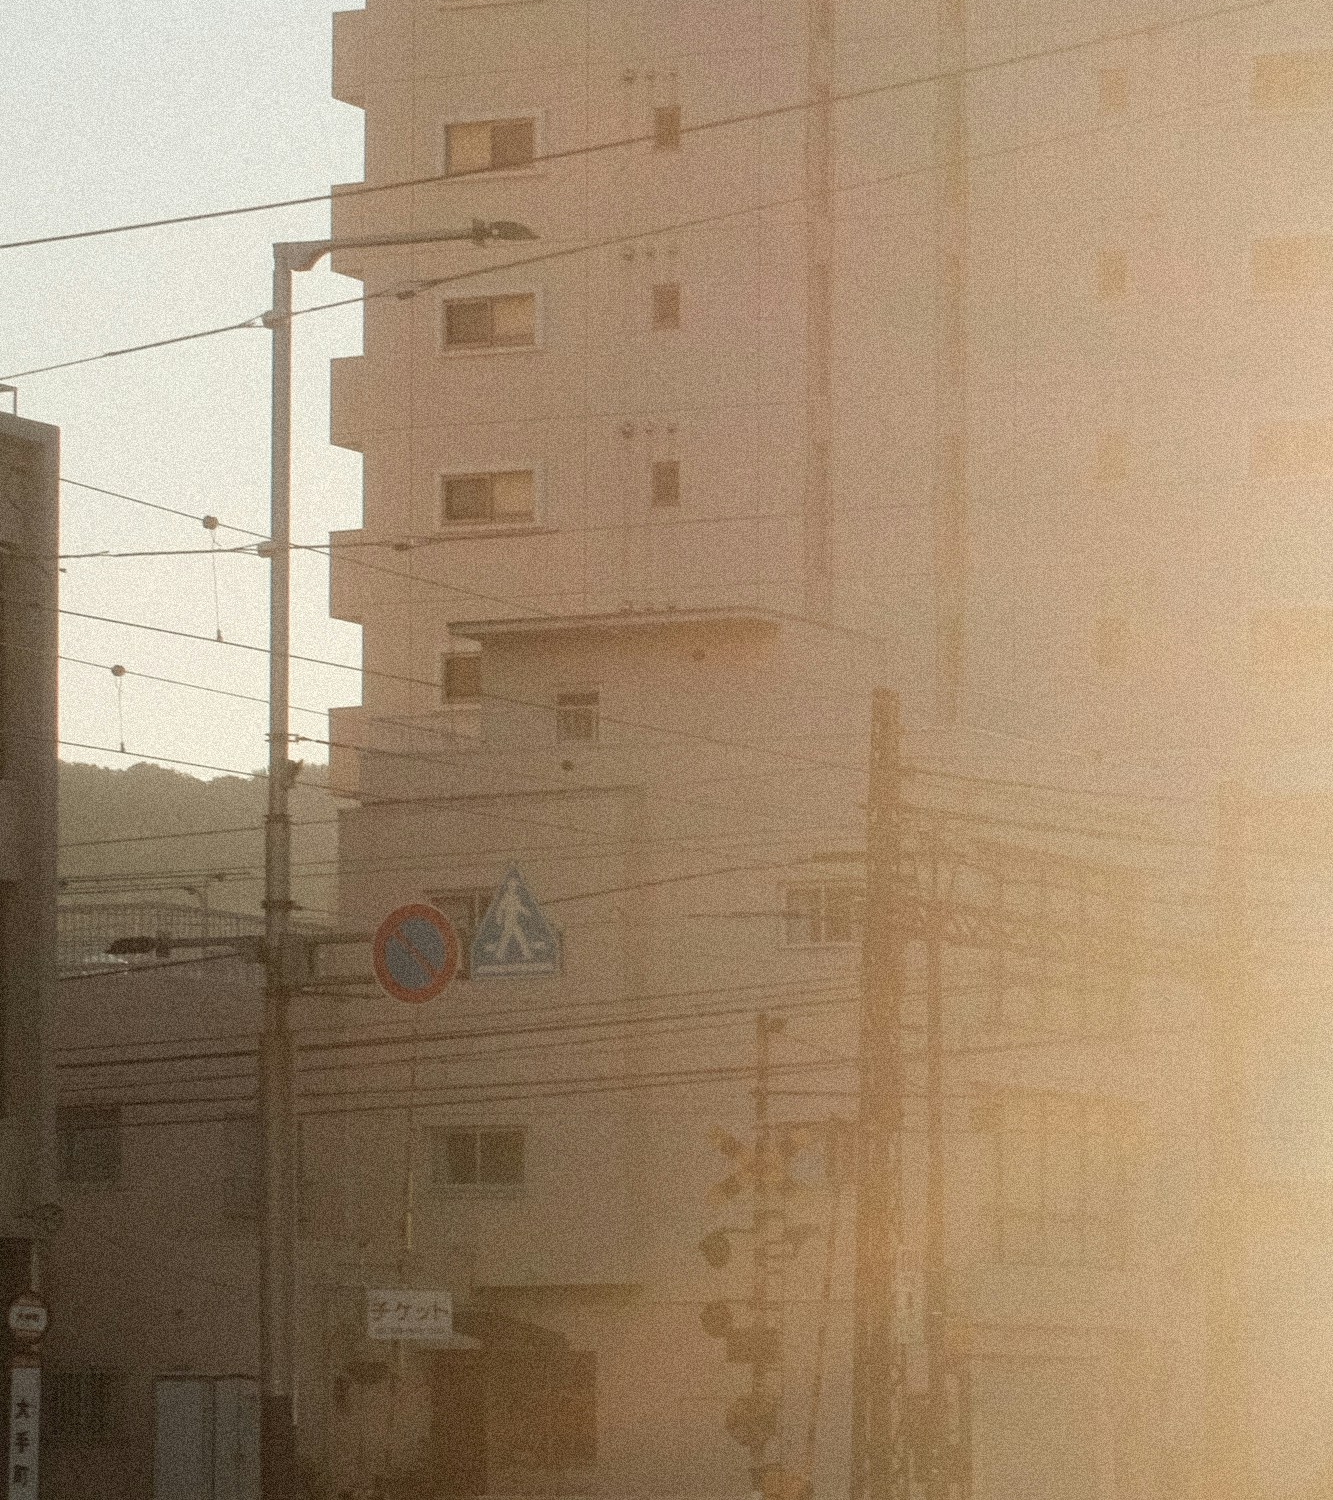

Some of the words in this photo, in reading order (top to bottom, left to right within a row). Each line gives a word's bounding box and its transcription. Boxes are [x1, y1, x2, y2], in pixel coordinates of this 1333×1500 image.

[370, 1300, 450, 1322] チケット
[13, 1397, 30, 1487] 大手町
